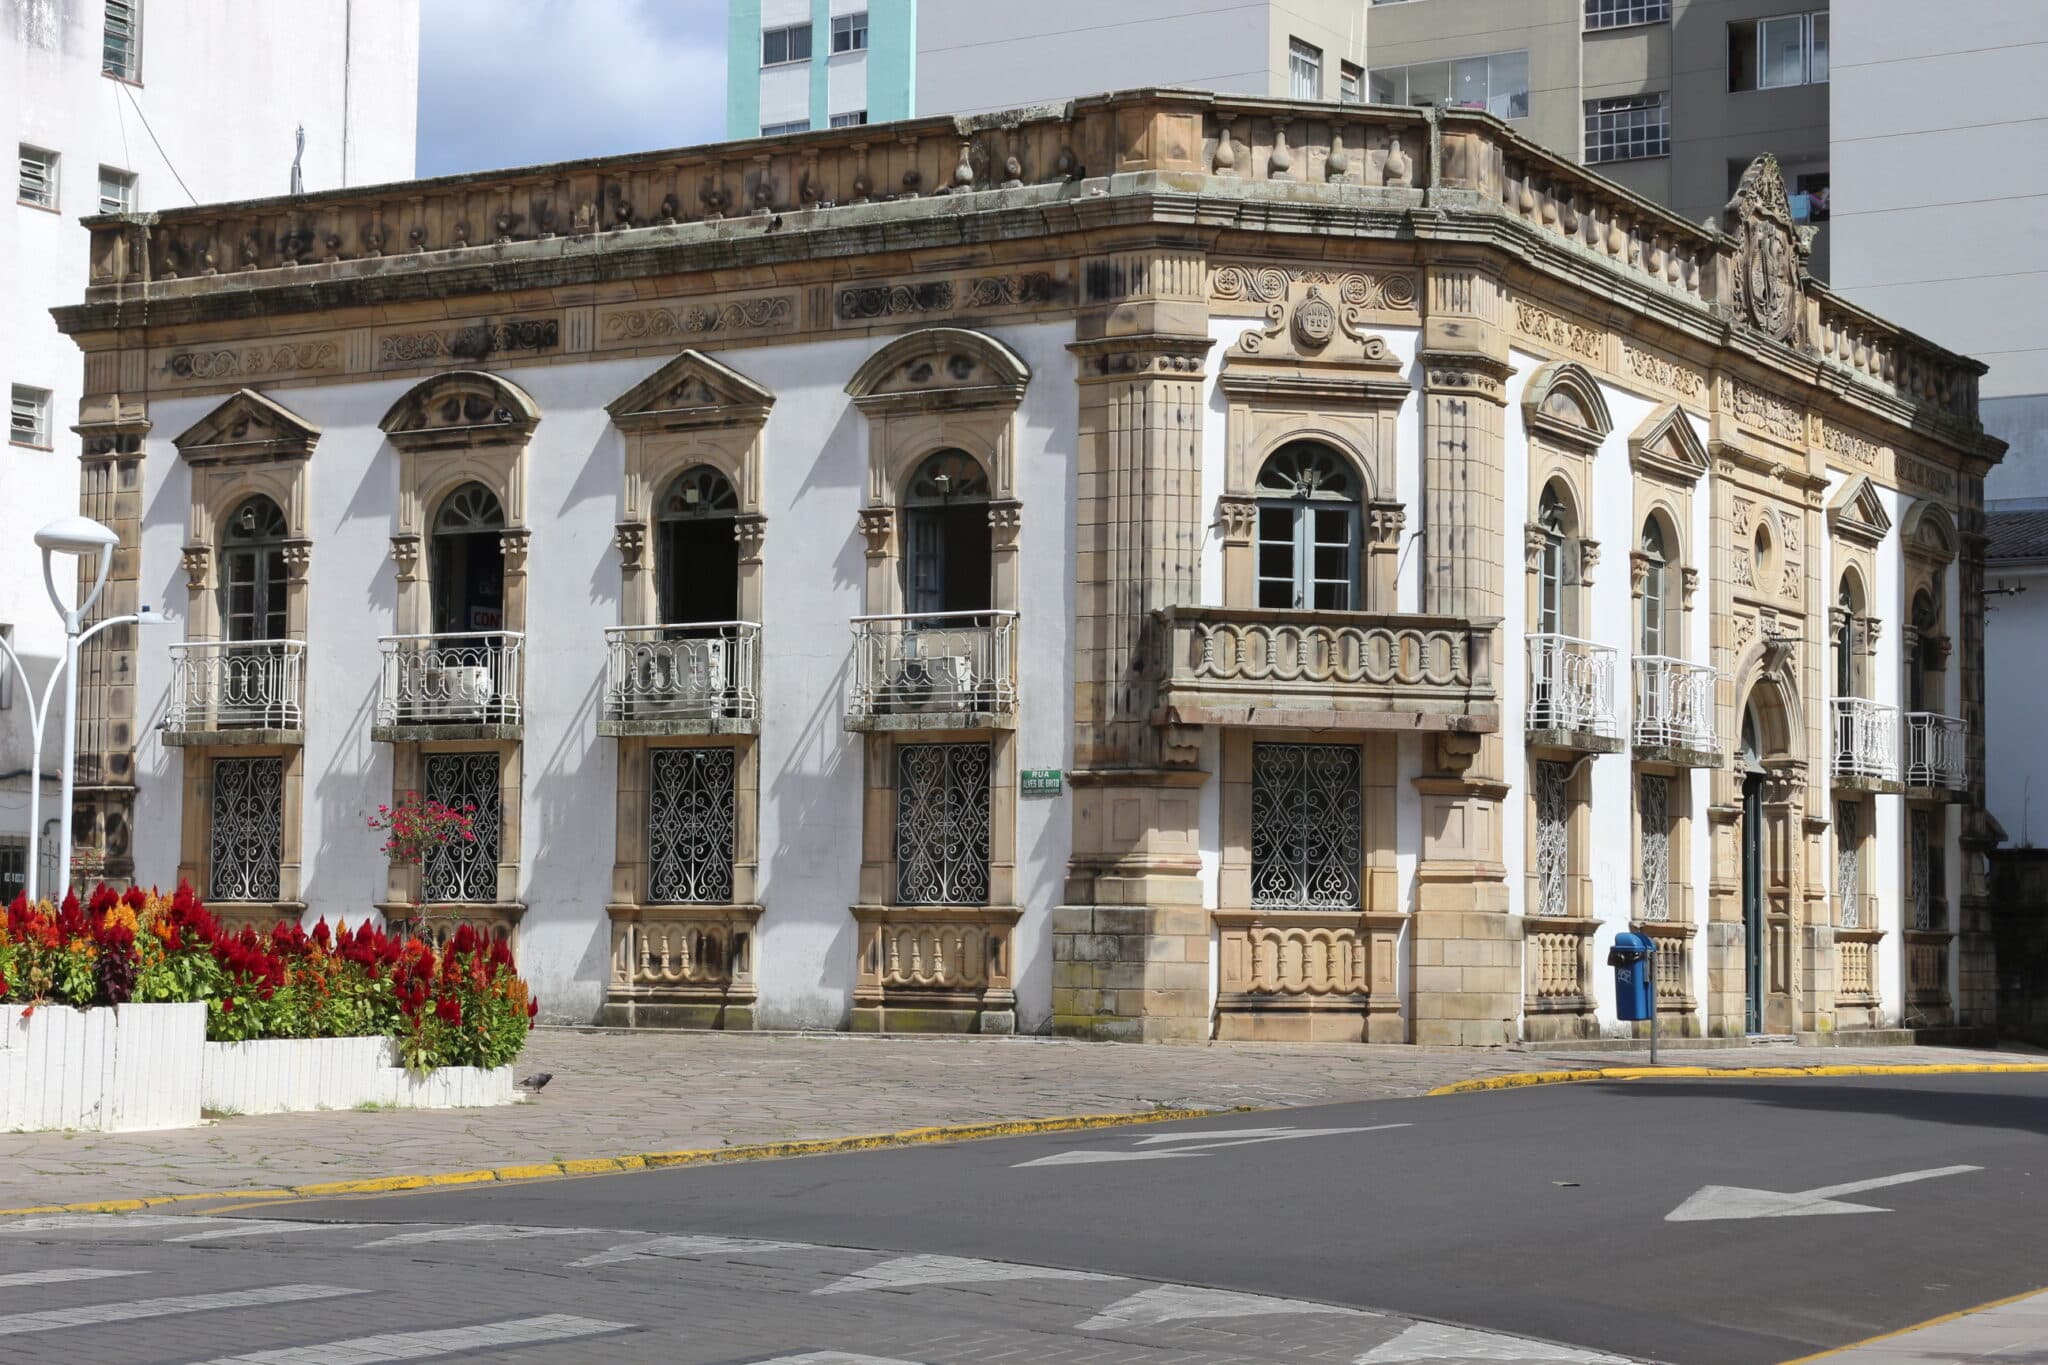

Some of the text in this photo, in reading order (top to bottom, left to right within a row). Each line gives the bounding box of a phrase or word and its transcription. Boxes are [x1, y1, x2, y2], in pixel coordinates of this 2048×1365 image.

[1306, 307, 1329, 317] ANNO
[474, 611, 502, 627] CON
[1023, 779, 1060, 788] ALVES DE BRITO
